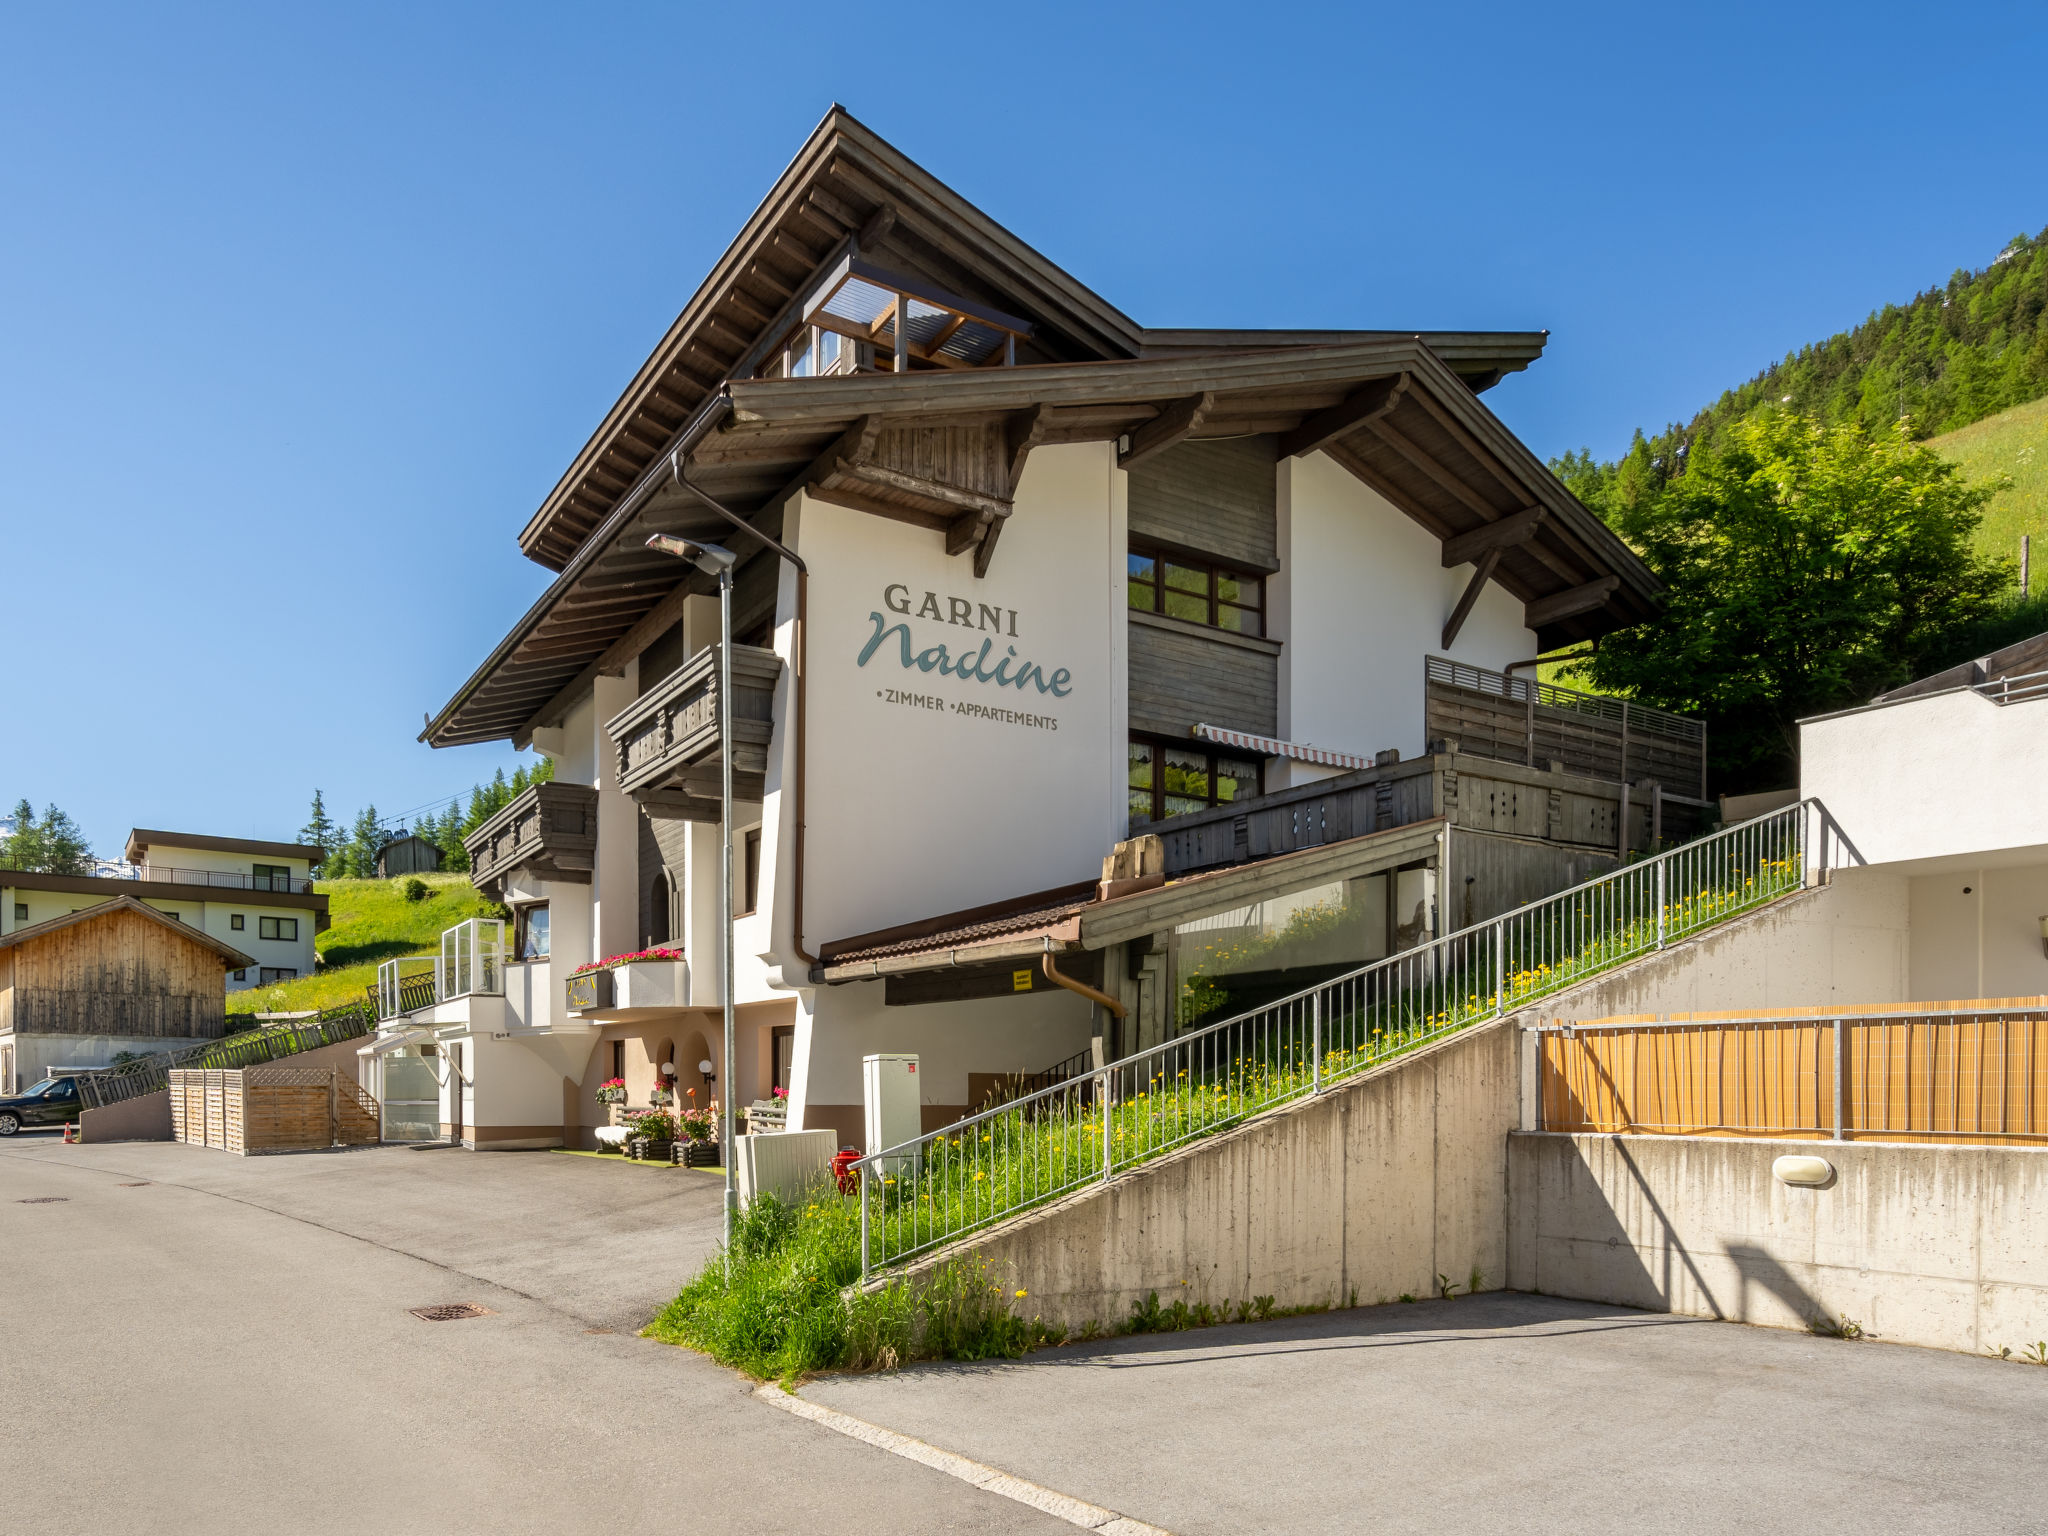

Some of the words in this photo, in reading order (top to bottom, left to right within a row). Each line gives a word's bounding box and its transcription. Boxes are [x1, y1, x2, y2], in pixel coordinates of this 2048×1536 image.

[884, 583, 1019, 638] GARNI
[857, 611, 1073, 698] Nadine
[885, 688, 944, 712] ZIMMER
[956, 701, 1058, 731] APPARTEMENTS
